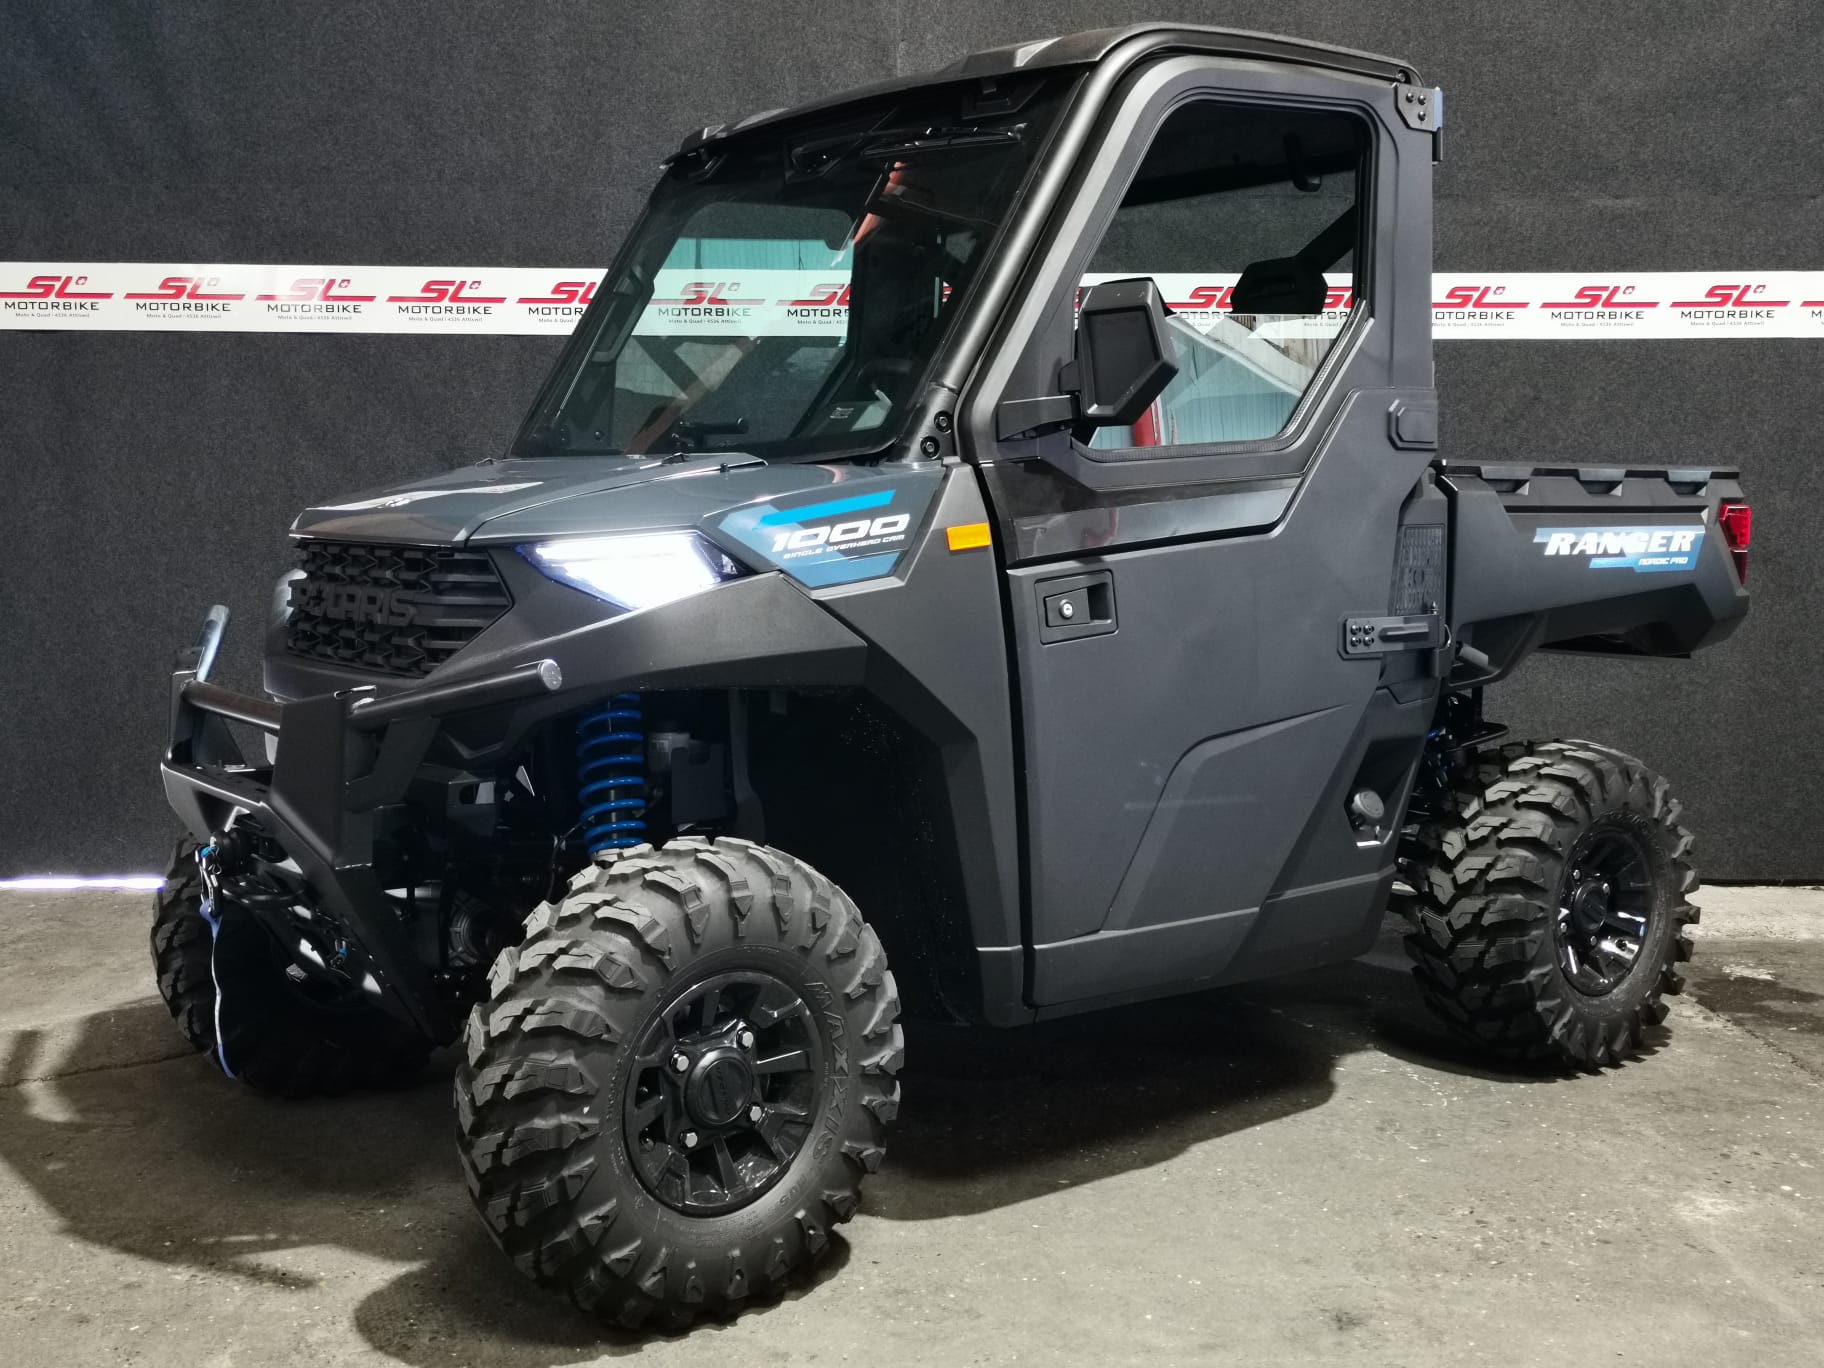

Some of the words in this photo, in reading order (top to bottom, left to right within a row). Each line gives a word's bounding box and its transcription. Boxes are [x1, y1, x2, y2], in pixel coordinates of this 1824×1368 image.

[4, 301, 99, 311] MOTORBIKE
[136, 302, 231, 312] MOTORBIKE
[267, 304, 362, 314] MOTORBIKE
[398, 305, 492, 315] MOTORBIKE
[528, 307, 584, 316] MOTOR
[658, 307, 751, 317] MOTORBIKE
[787, 308, 849, 317] MOTOR
[1435, 311, 1515, 320] OTORBIKE
[1551, 311, 1645, 320] MOTORBIKE
[1681, 310, 1775, 319] MOTORBIKE
[772, 513, 910, 552] 1000
[1544, 531, 1696, 555] RANGER
[783, 548, 824, 560] SINGLE
